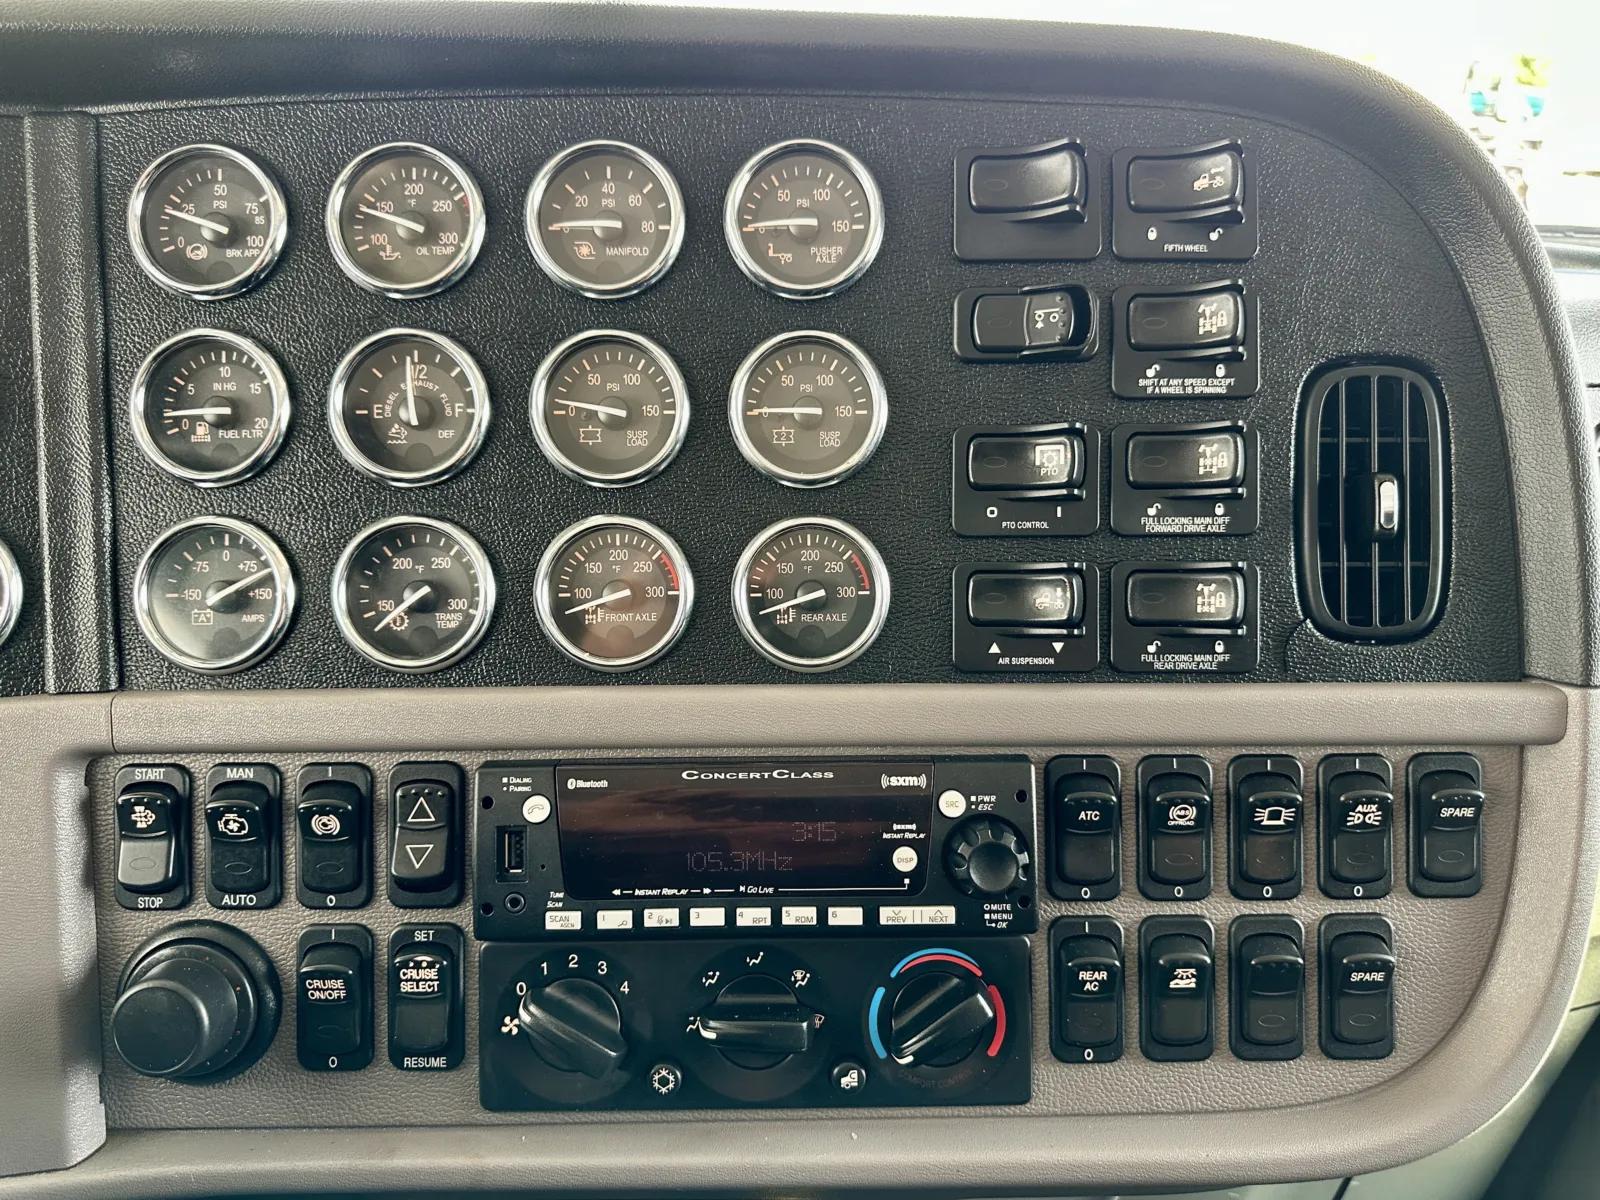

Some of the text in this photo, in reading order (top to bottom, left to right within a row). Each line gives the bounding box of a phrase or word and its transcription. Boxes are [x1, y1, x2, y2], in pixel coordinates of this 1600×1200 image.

[214, 185, 227, 196] 50
[404, 184, 424, 195] 200
[602, 183, 615, 194] 40
[778, 190, 790, 201] 50
[813, 189, 830, 200] 100
[213, 201, 227, 209] PSI
[433, 201, 452, 212] 250
[576, 196, 588, 207] 20
[602, 200, 615, 208] PSI
[628, 196, 642, 206] 60
[796, 200, 810, 208] PSI
[182, 204, 195, 214] 25
[245, 203, 259, 214] 75
[376, 202, 393, 213] 150
[641, 221, 654, 233] 80
[832, 221, 849, 232] 150
[178, 236, 185, 248] 0
[246, 236, 264, 247] 100
[370, 234, 388, 245] 100
[439, 233, 458, 244] 300
[226, 249, 260, 258] BRK APP
[416, 246, 455, 255] OIL TEMP
[606, 248, 649, 256] MANIFOLD
[810, 247, 842, 255] PUSHER
[1164, 244, 1208, 252] FIFTH WHEEL
[816, 255, 837, 263] AXLE
[219, 367, 231, 378] 10
[588, 374, 600, 385] 50
[623, 374, 640, 385] 100
[781, 375, 794, 386] 50
[816, 375, 834, 386] 100
[1138, 378, 1235, 386] SHIFT AT ANY SPEED EXCEPT
[188, 384, 194, 395] 5
[213, 383, 236, 391] IN HG
[249, 383, 261, 394] 15
[606, 383, 620, 391] PSI
[800, 384, 812, 392] PSI
[1146, 386, 1227, 394] IF A WHEEL IS SPINNING
[384, 380, 452, 417] DIESEL EHAUST FLUID
[374, 404, 383, 418] E
[454, 403, 464, 417] F
[568, 406, 576, 416] 0
[642, 405, 660, 416] 150
[835, 406, 852, 417] 150
[182, 419, 189, 430] 0
[254, 418, 268, 429] 20
[219, 430, 264, 439] FUEL FLTR
[438, 430, 456, 439] DEF
[626, 430, 648, 438] SUSP
[819, 431, 840, 439] SUSP
[626, 439, 648, 447] LOAD
[819, 439, 840, 447] LOAD
[1040, 468, 1058, 476] PTO
[1141, 517, 1159, 525] FULL
[1160, 517, 1192, 525] LOCKING
[223, 550, 230, 561] 0
[609, 550, 628, 561] 200
[801, 550, 820, 561] 200
[192, 562, 209, 572] -75
[238, 561, 257, 572] +75
[392, 558, 412, 569] 200
[431, 558, 450, 569] 250
[584, 563, 602, 574] 150
[633, 562, 652, 573] 250
[776, 563, 794, 574] 150
[824, 562, 844, 573] 250
[248, 589, 272, 600] +150
[574, 588, 592, 599] 100
[646, 587, 665, 598] 300
[766, 588, 784, 599] 100
[837, 587, 856, 598] 300
[377, 600, 394, 611] 150
[448, 599, 467, 610] 300
[241, 614, 265, 622] AMPS
[435, 613, 462, 621] TRANS
[605, 613, 657, 622] FRONT AXLE
[801, 614, 847, 622] REAR AXLE
[437, 621, 460, 629] TEMP
[1141, 654, 1231, 662] FULL LOCKING MAIN DIFF
[1154, 662, 1218, 670] REAR DRIVE AXLE
[135, 768, 165, 780] START
[226, 768, 254, 779] MAN
[576, 780, 608, 788] Bluetooth
[1079, 811, 1100, 820] ATC
[1440, 808, 1475, 817] SPARE
[792, 822, 837, 842] 3:15
[138, 897, 163, 908] STOP
[222, 895, 257, 906] AUTO
[997, 921, 1008, 929] OK
[414, 930, 435, 941] SET
[568, 954, 578, 968] 2
[541, 962, 548, 975] 1
[598, 961, 608, 974] 3
[400, 968, 439, 980] CRUISE
[1079, 971, 1108, 980] REAR
[1350, 972, 1385, 982] SPARE
[306, 980, 345, 989] CRUISE
[400, 981, 440, 992] SELECT
[516, 982, 526, 995] 0
[620, 981, 629, 994] 4
[1084, 982, 1099, 991] AC
[308, 990, 347, 1000] ON/OFF
[404, 1057, 447, 1068] RESUME
